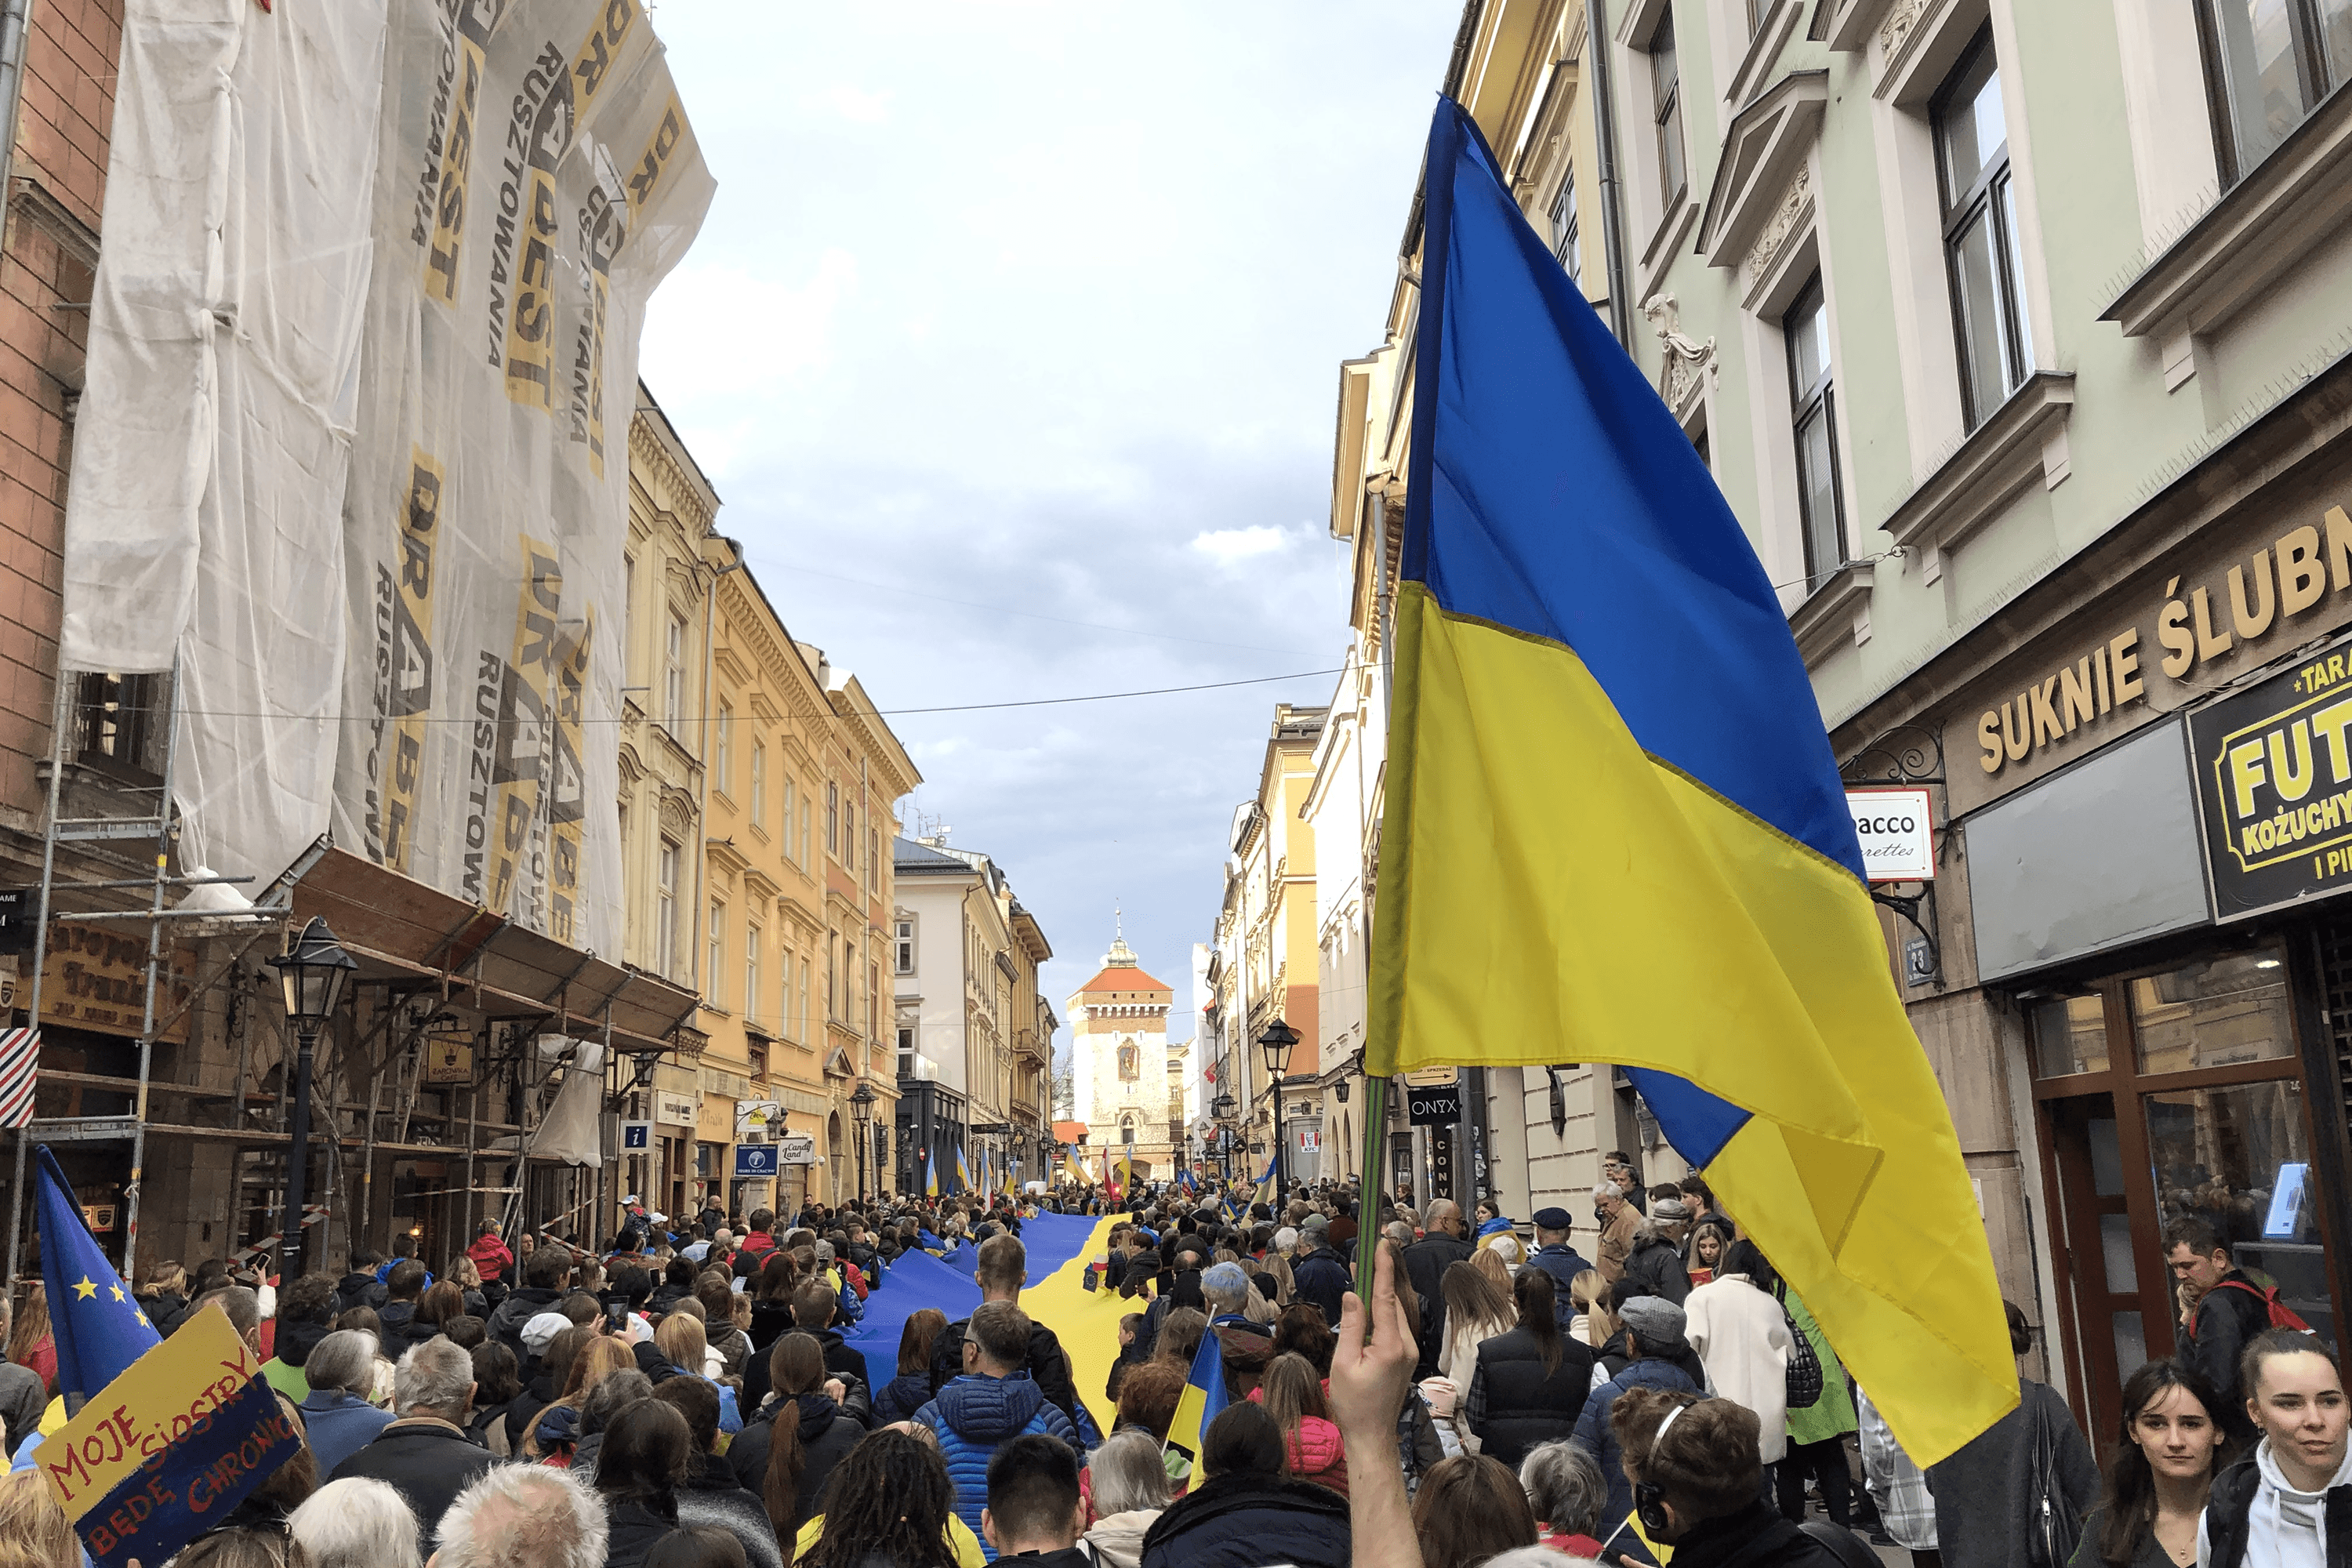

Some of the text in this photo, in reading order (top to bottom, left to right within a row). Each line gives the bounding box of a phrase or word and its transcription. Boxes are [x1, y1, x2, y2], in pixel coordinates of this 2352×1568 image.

[488, 39, 566, 368] RUSZTOWANIA
[2301, 648, 2352, 695] TAR
[1977, 626, 2144, 774] SUKNIE
[461, 649, 503, 903] RUSZTOW
[2229, 697, 2352, 820] FUT
[1853, 816, 1915, 835] acco
[1861, 843, 1915, 858] rettes
[2327, 846, 2352, 877] PI
[1411, 1099, 1457, 1116] ONYX
[782, 1147, 801, 1161] Land
[787, 1143, 811, 1153] Candy
[48, 1404, 143, 1501] MOJE
